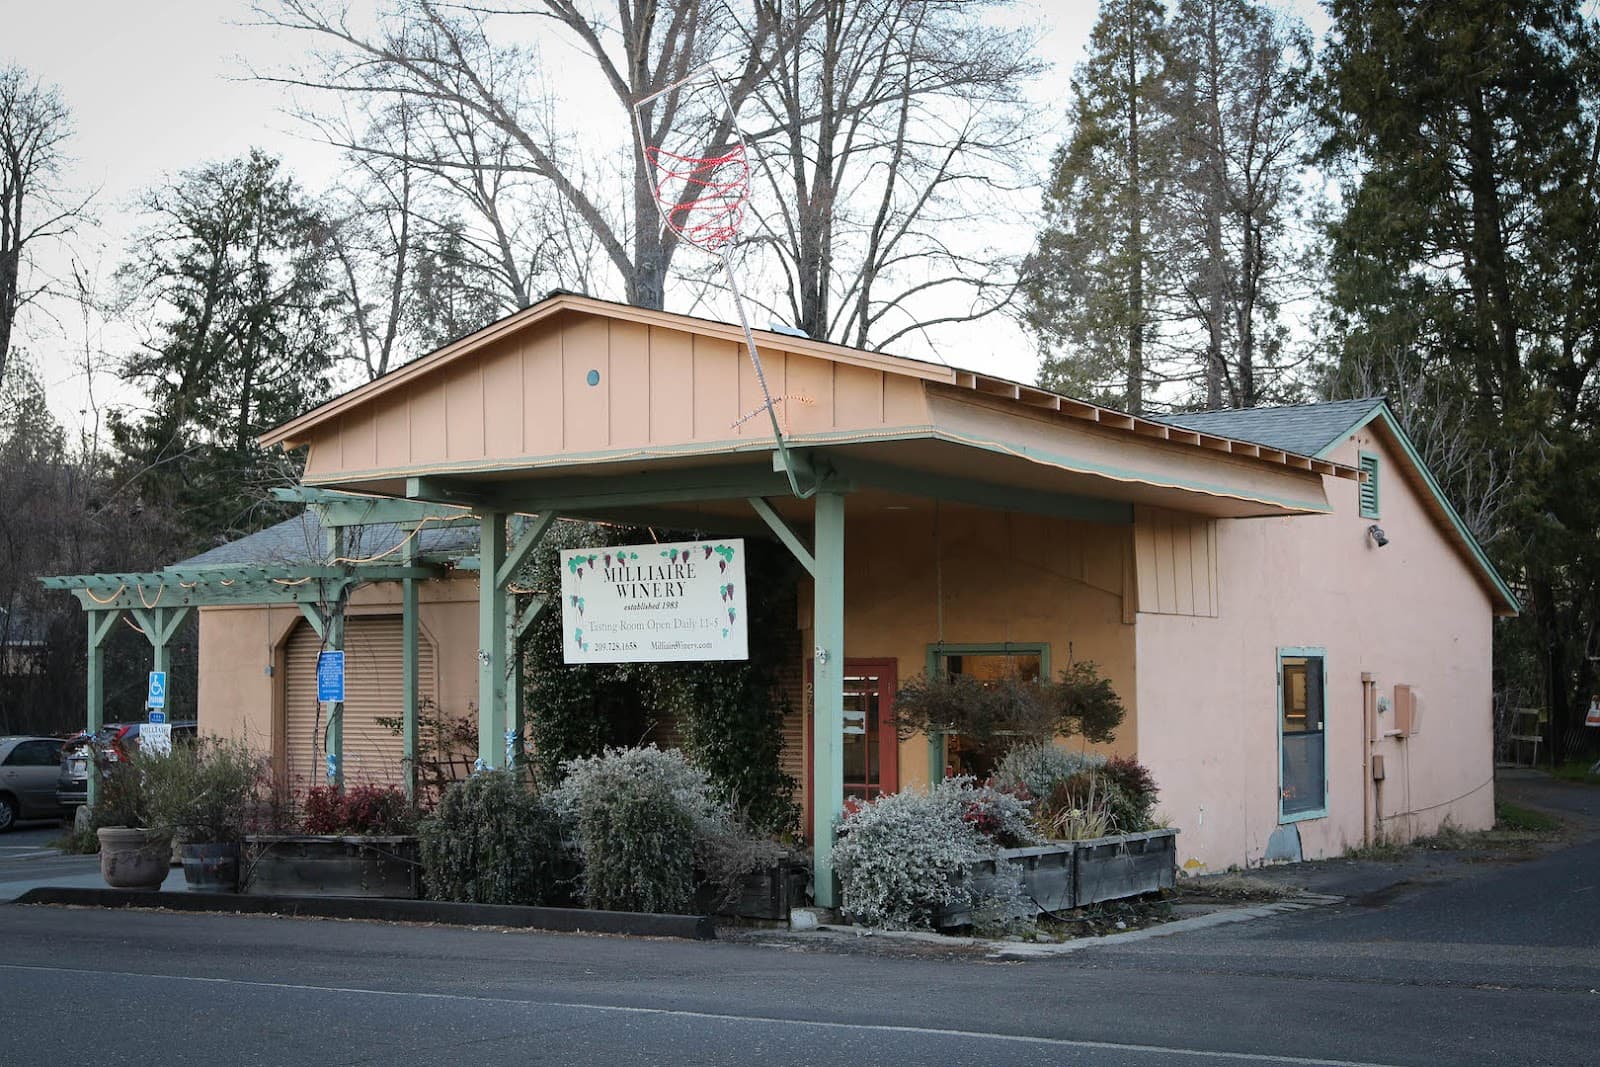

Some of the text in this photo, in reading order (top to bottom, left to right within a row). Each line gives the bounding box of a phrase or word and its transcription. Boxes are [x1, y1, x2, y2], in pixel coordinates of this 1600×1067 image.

[603, 563, 697, 583] MILLIAIRE
[616, 581, 687, 599] WINERY
[623, 601, 679, 611] established 1983
[588, 620, 618, 633] Tasting
[620, 619, 645, 631] Room
[647, 618, 672, 632] Open
[673, 617, 697, 631] Daily
